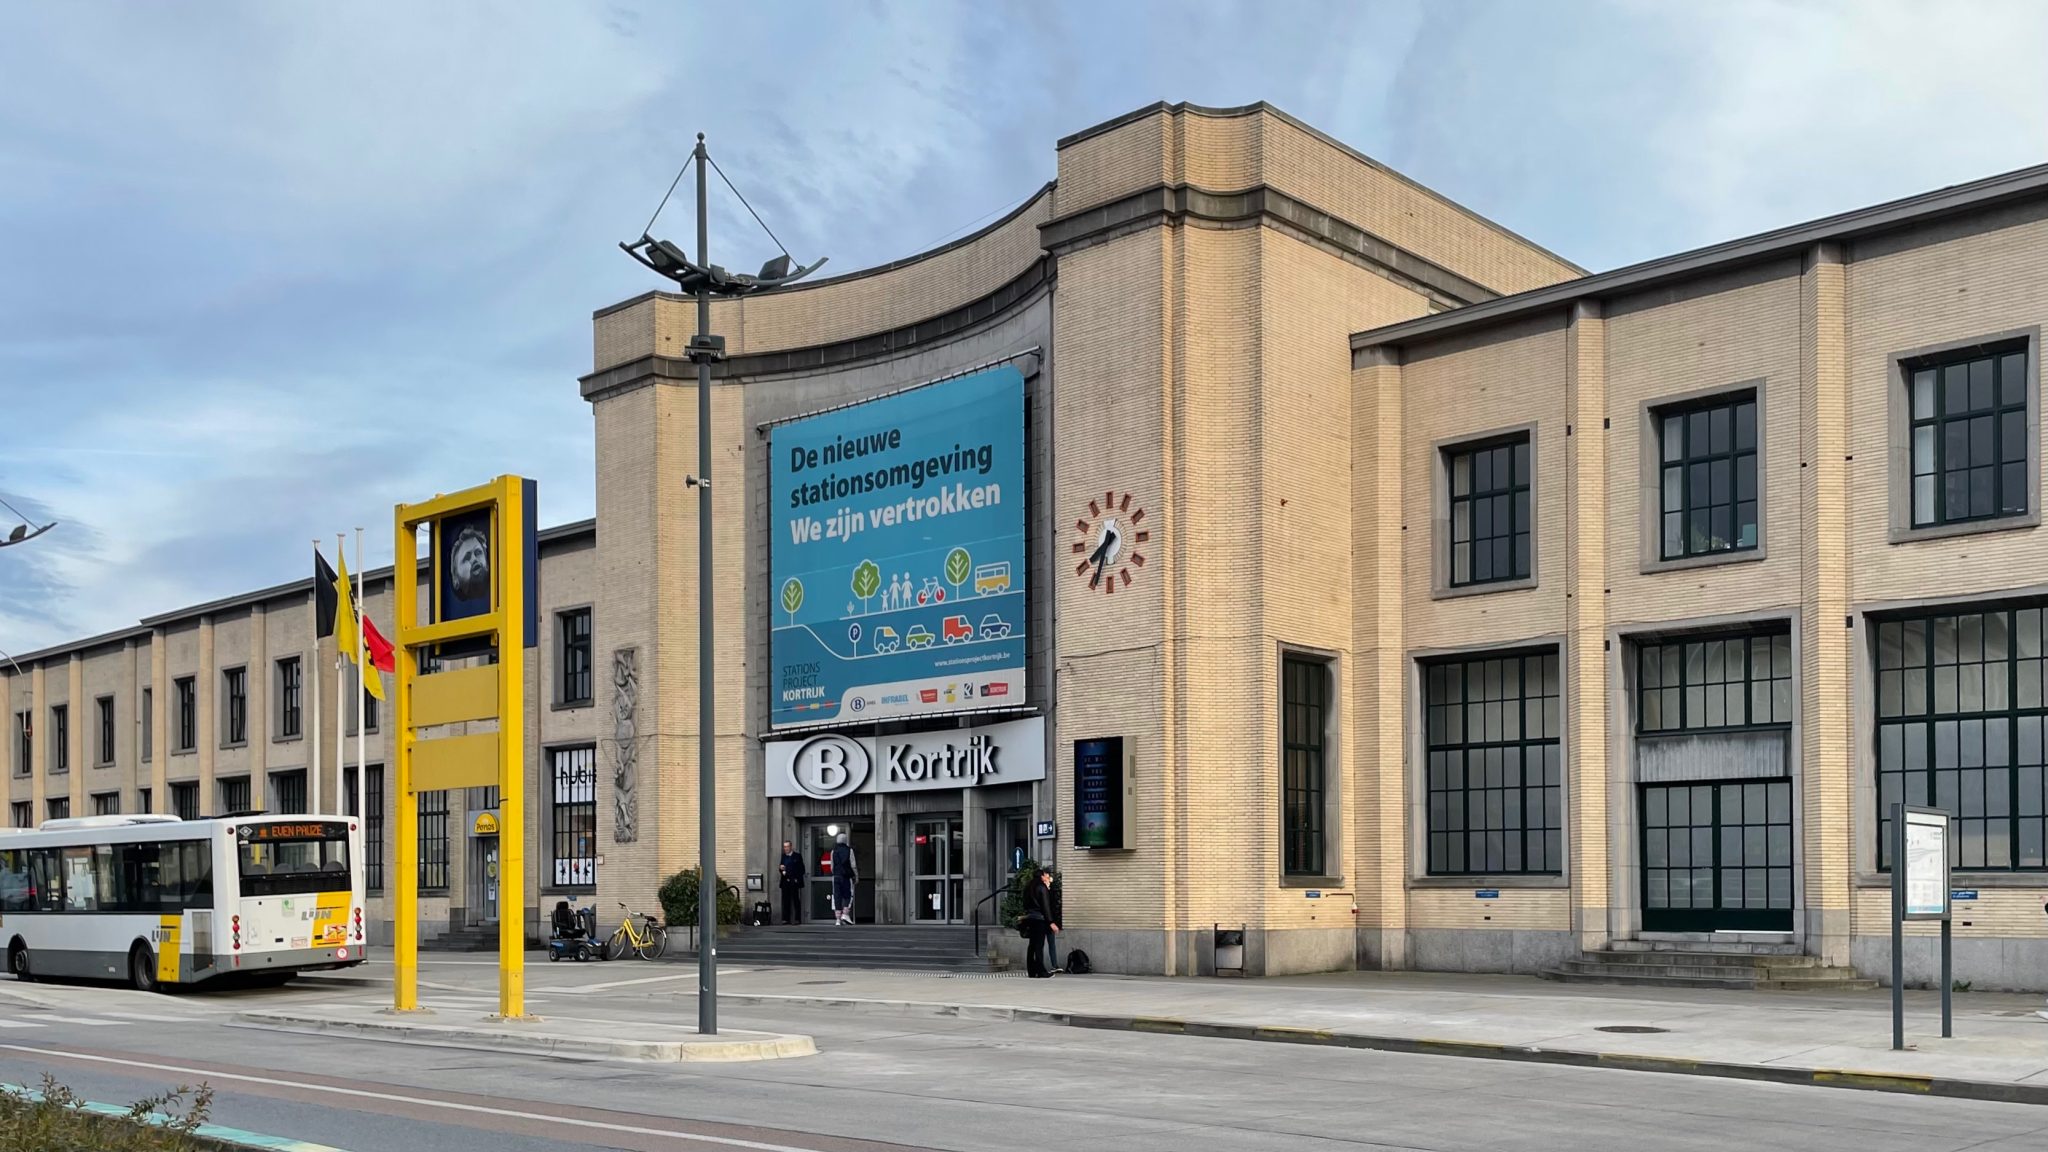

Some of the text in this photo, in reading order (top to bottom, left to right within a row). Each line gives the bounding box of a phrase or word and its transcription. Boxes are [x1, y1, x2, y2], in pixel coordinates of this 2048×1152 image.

[791, 429, 901, 473] De nieuwe
[790, 443, 993, 508] stationsomgeving
[790, 482, 1001, 544] We zijn vertrokken
[783, 661, 821, 677] STATIONS
[783, 674, 818, 690] PROJECT
[783, 686, 826, 702] KORTRIJK
[886, 735, 998, 785] Kortrijk
